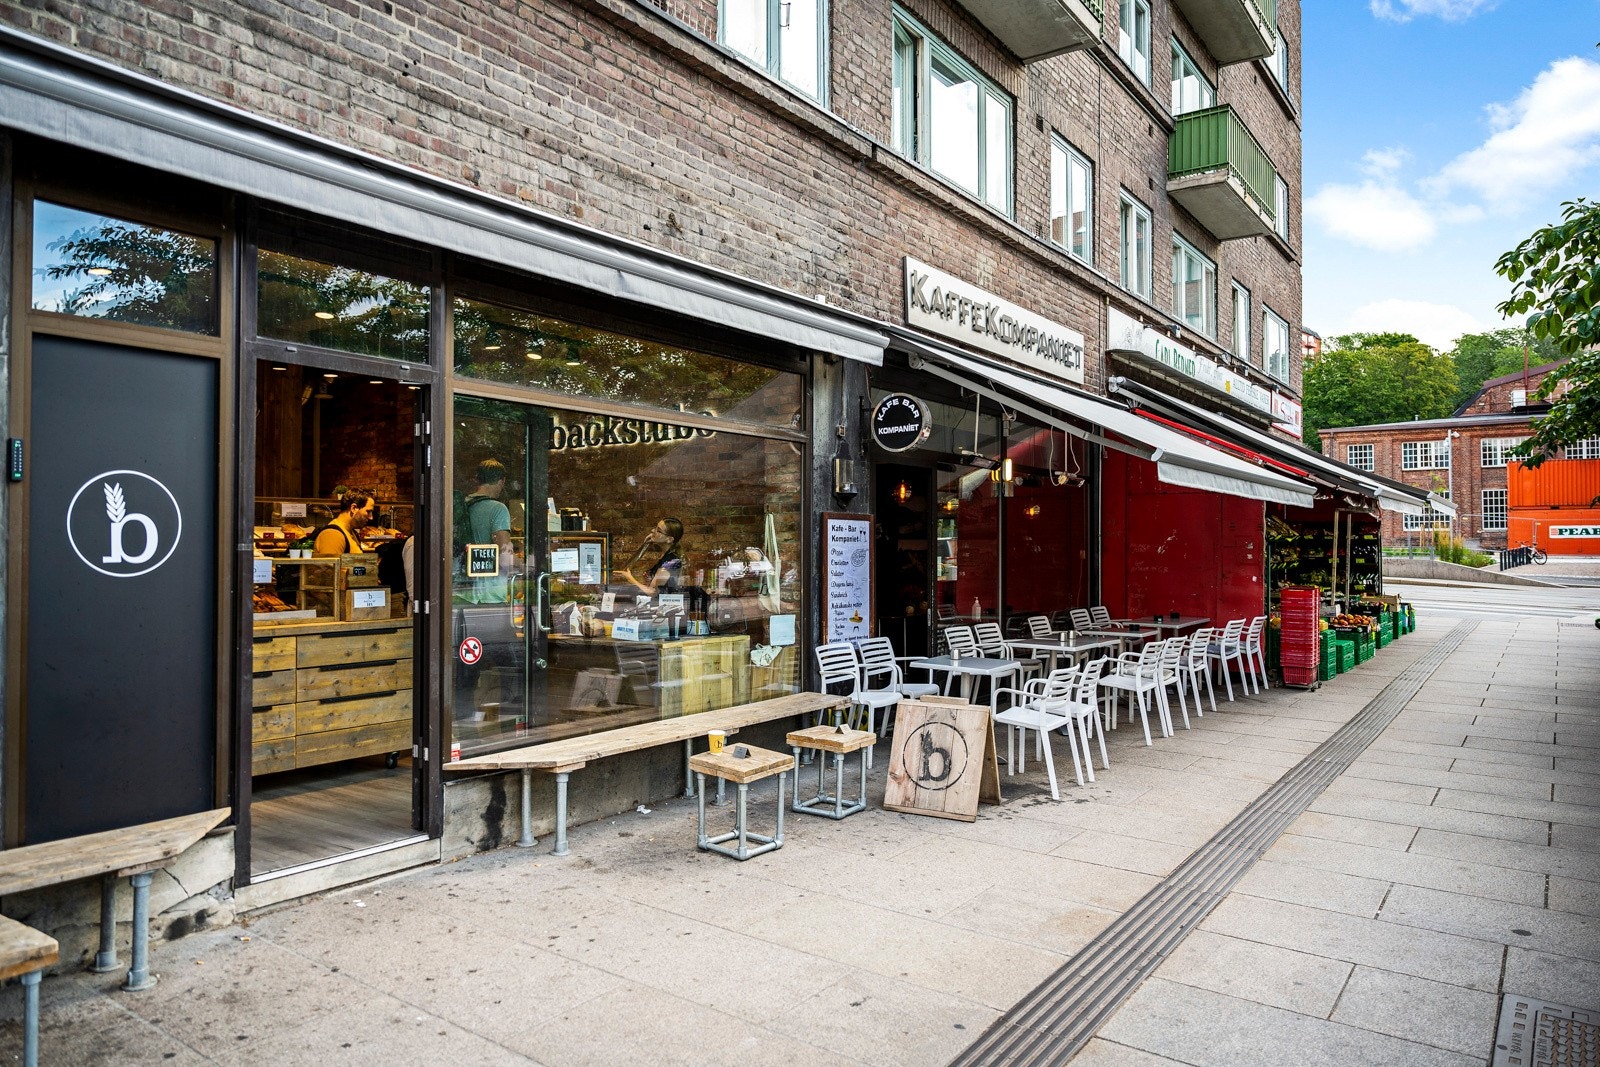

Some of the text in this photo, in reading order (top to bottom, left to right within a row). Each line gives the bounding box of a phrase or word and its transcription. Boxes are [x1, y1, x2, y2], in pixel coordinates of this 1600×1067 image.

[877, 398, 920, 421] KAFE BAR
[831, 524, 844, 532] Kafe
[831, 535, 859, 544] Kompaniet
[473, 548, 495, 558] TREKK
[918, 730, 952, 782] b
